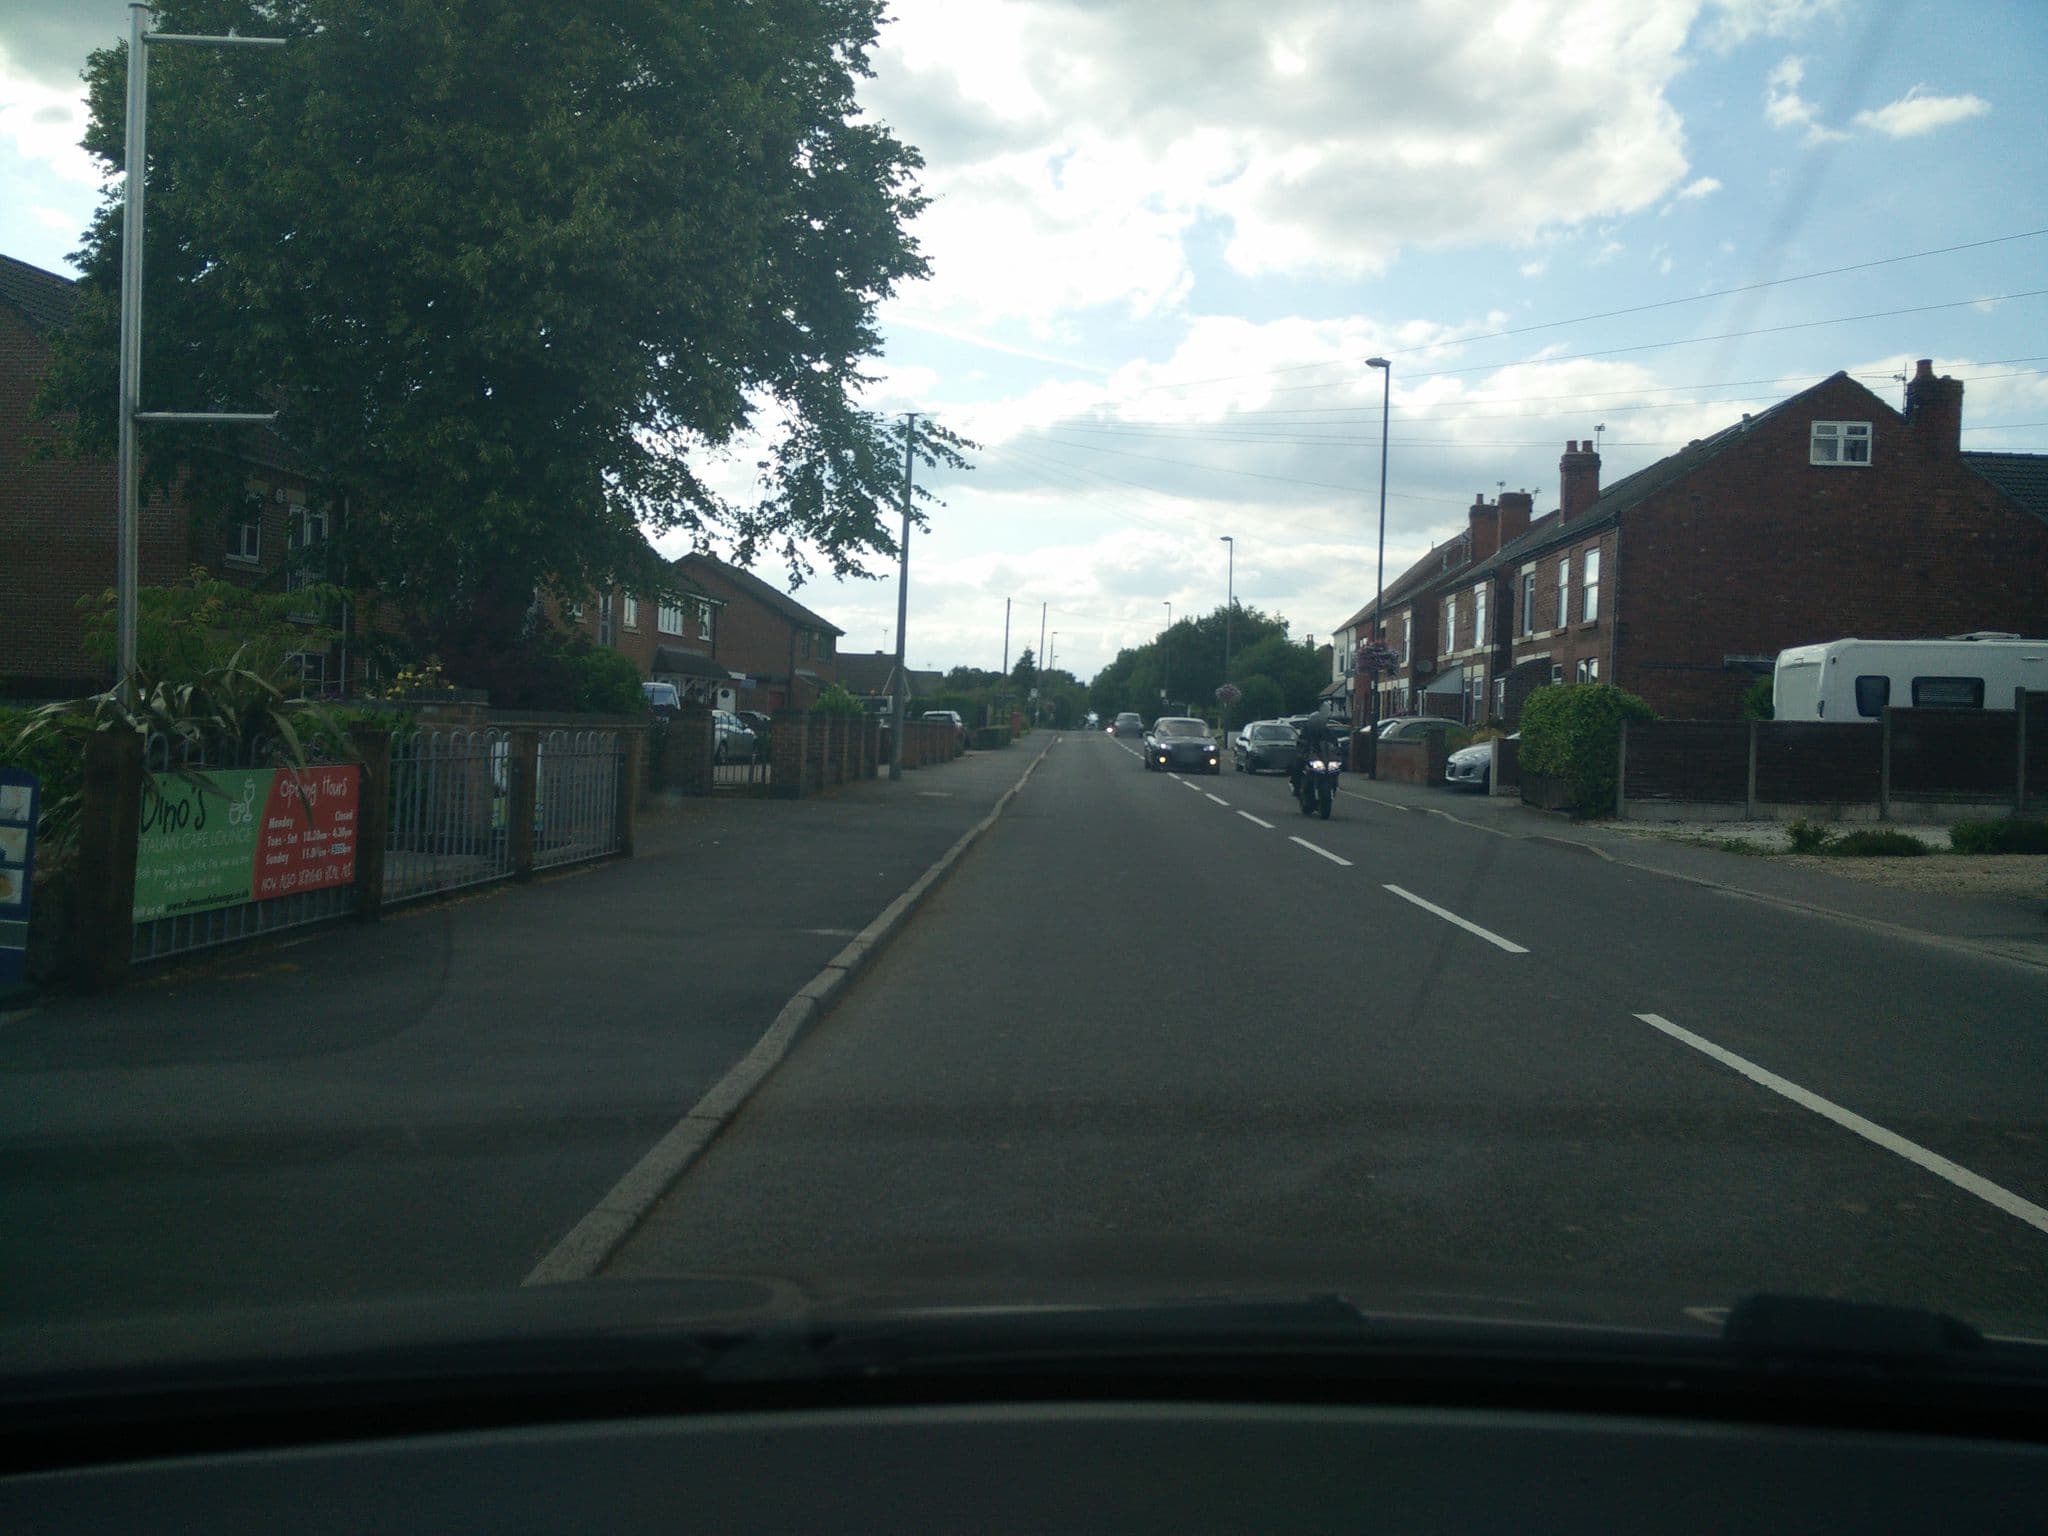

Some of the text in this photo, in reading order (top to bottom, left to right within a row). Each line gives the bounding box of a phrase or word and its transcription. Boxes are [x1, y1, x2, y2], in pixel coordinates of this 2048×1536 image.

[322, 775, 348, 797] Hours
[139, 776, 207, 834] Dino's
[268, 816, 295, 829] Monday
